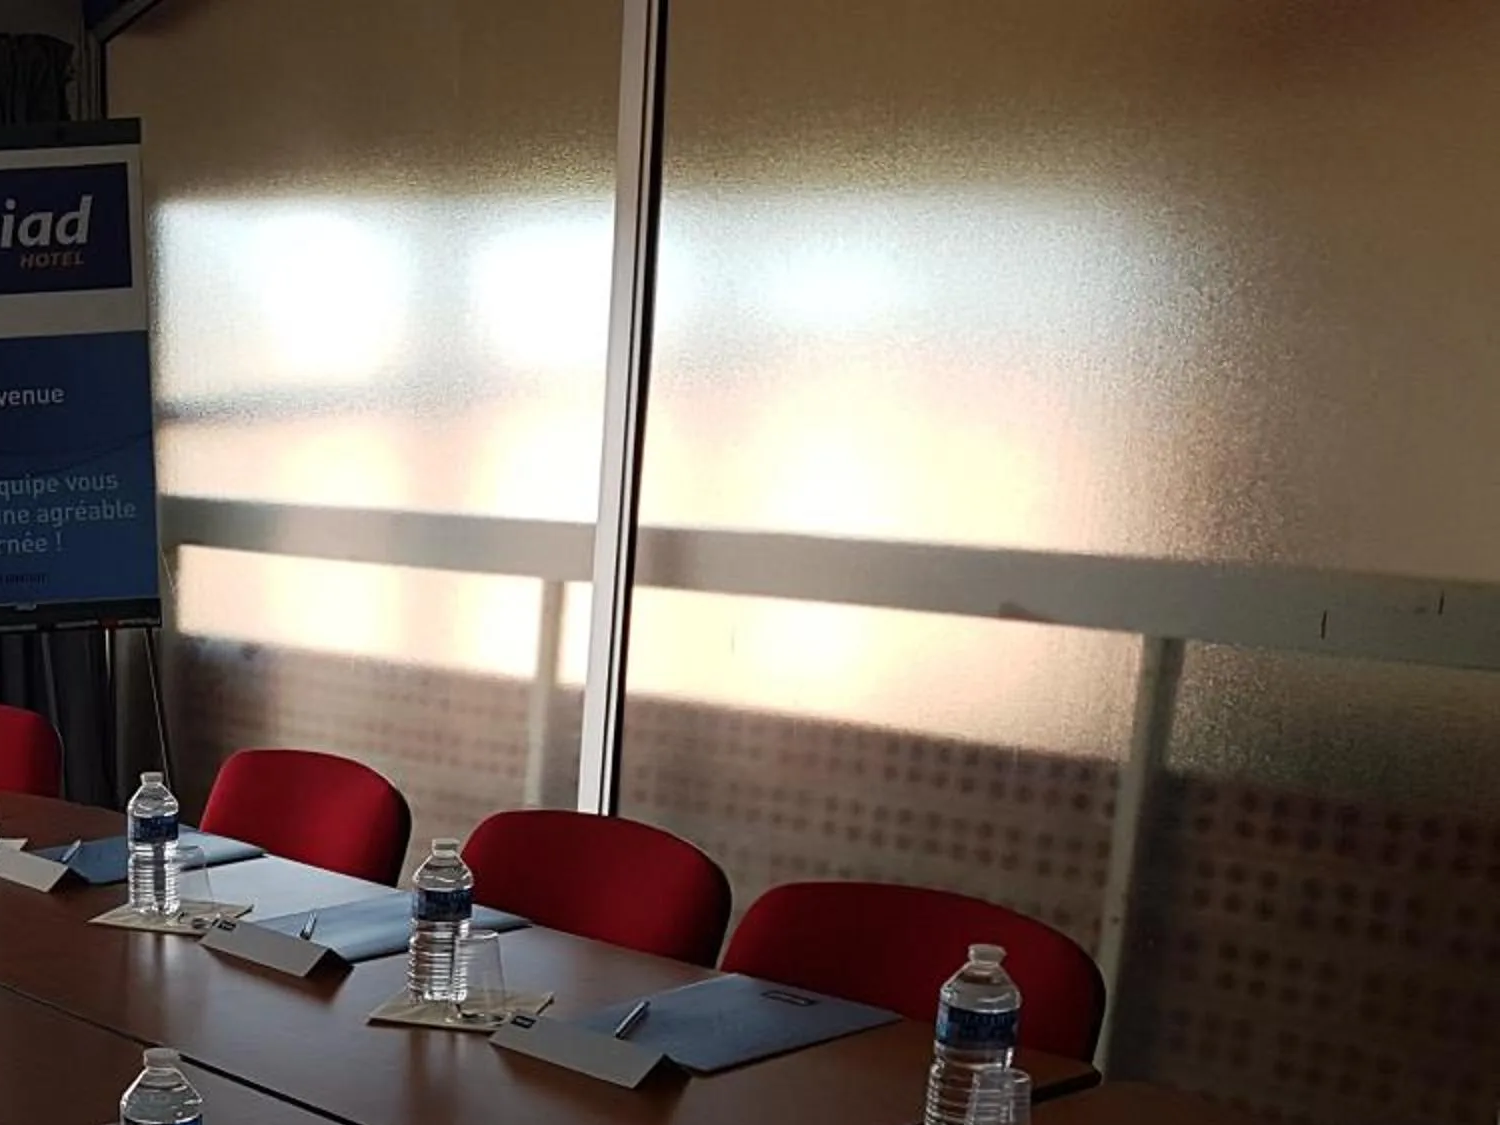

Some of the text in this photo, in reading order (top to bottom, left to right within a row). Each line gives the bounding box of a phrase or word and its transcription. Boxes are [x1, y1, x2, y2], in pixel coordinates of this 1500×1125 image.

[20, 251, 85, 269] HOTEL
[66, 472, 119, 492] vous
[36, 499, 136, 528] agréable
